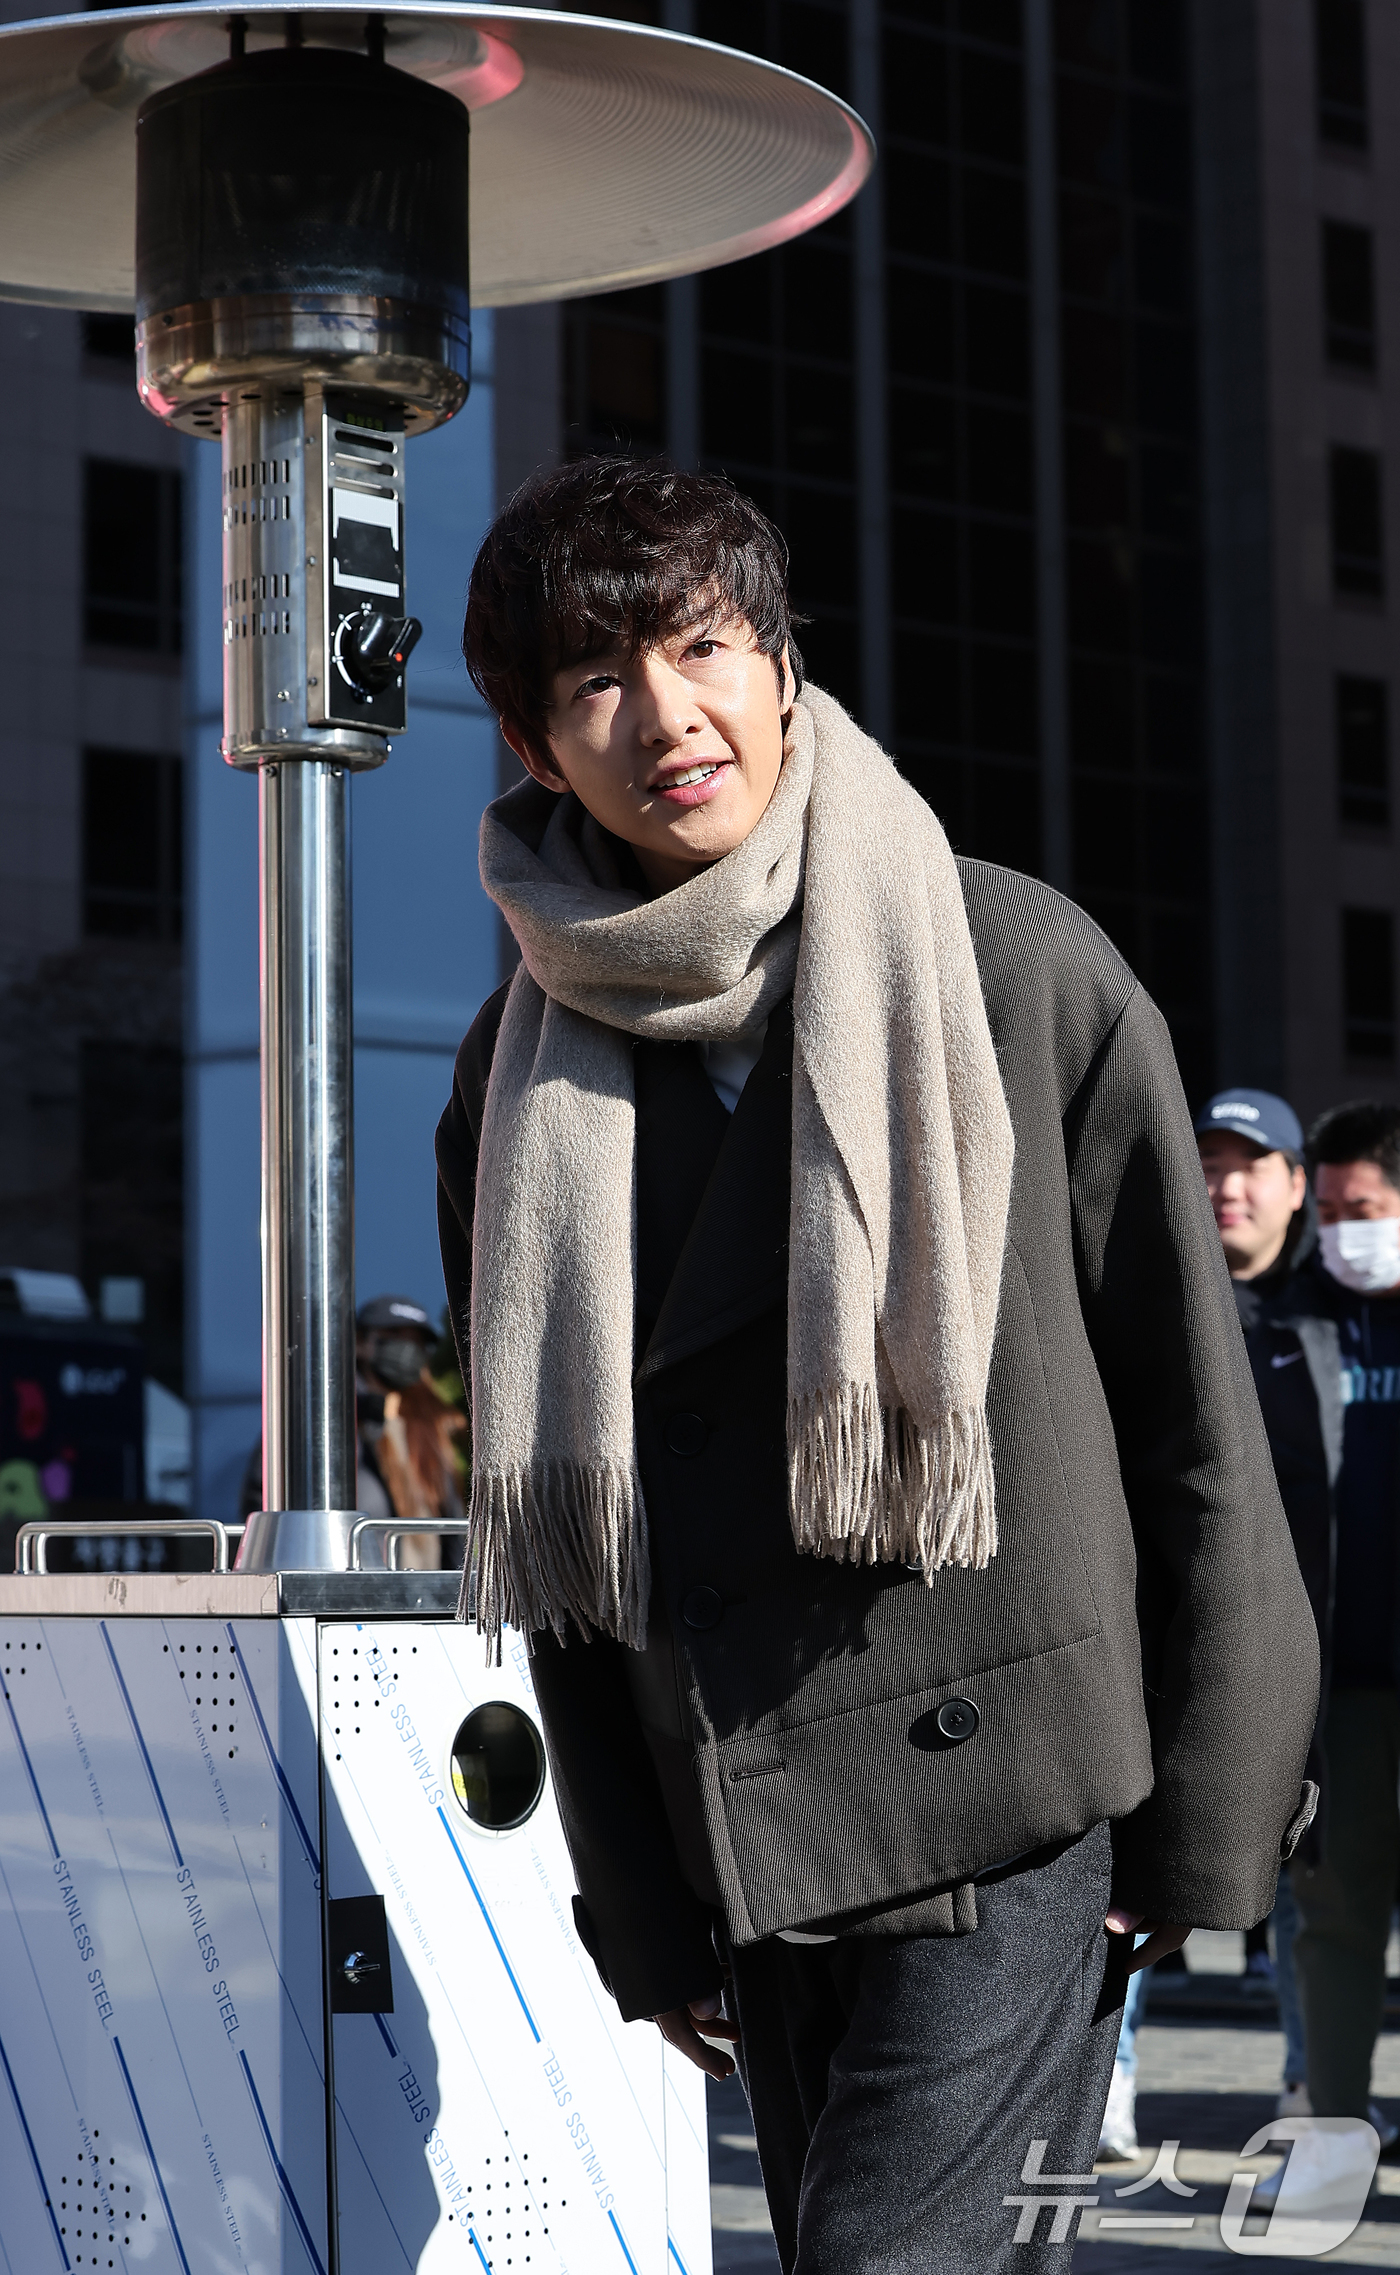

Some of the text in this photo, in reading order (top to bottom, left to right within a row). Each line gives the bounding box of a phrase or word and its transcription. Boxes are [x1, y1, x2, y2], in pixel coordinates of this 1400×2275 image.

[65, 1704, 104, 1811] STAINLESS STEEL
[189, 1708, 230, 1817] STAINLESS STEEL
[364, 1638, 445, 1805] STAINLESS STEEL
[53, 1860, 114, 2029] STAINLESS STEEL
[176, 1868, 240, 2041] STAINLESS STEEL
[386, 1861, 437, 1966] STAINLESS STEEL
[531, 1854, 579, 1955] STAINLESS STEEL
[202, 2133, 241, 2244] STAINLESS STEEL
[397, 2064, 475, 2227] STAINLESS STEEL
[542, 2050, 615, 2209] STAINLESS STEEL
